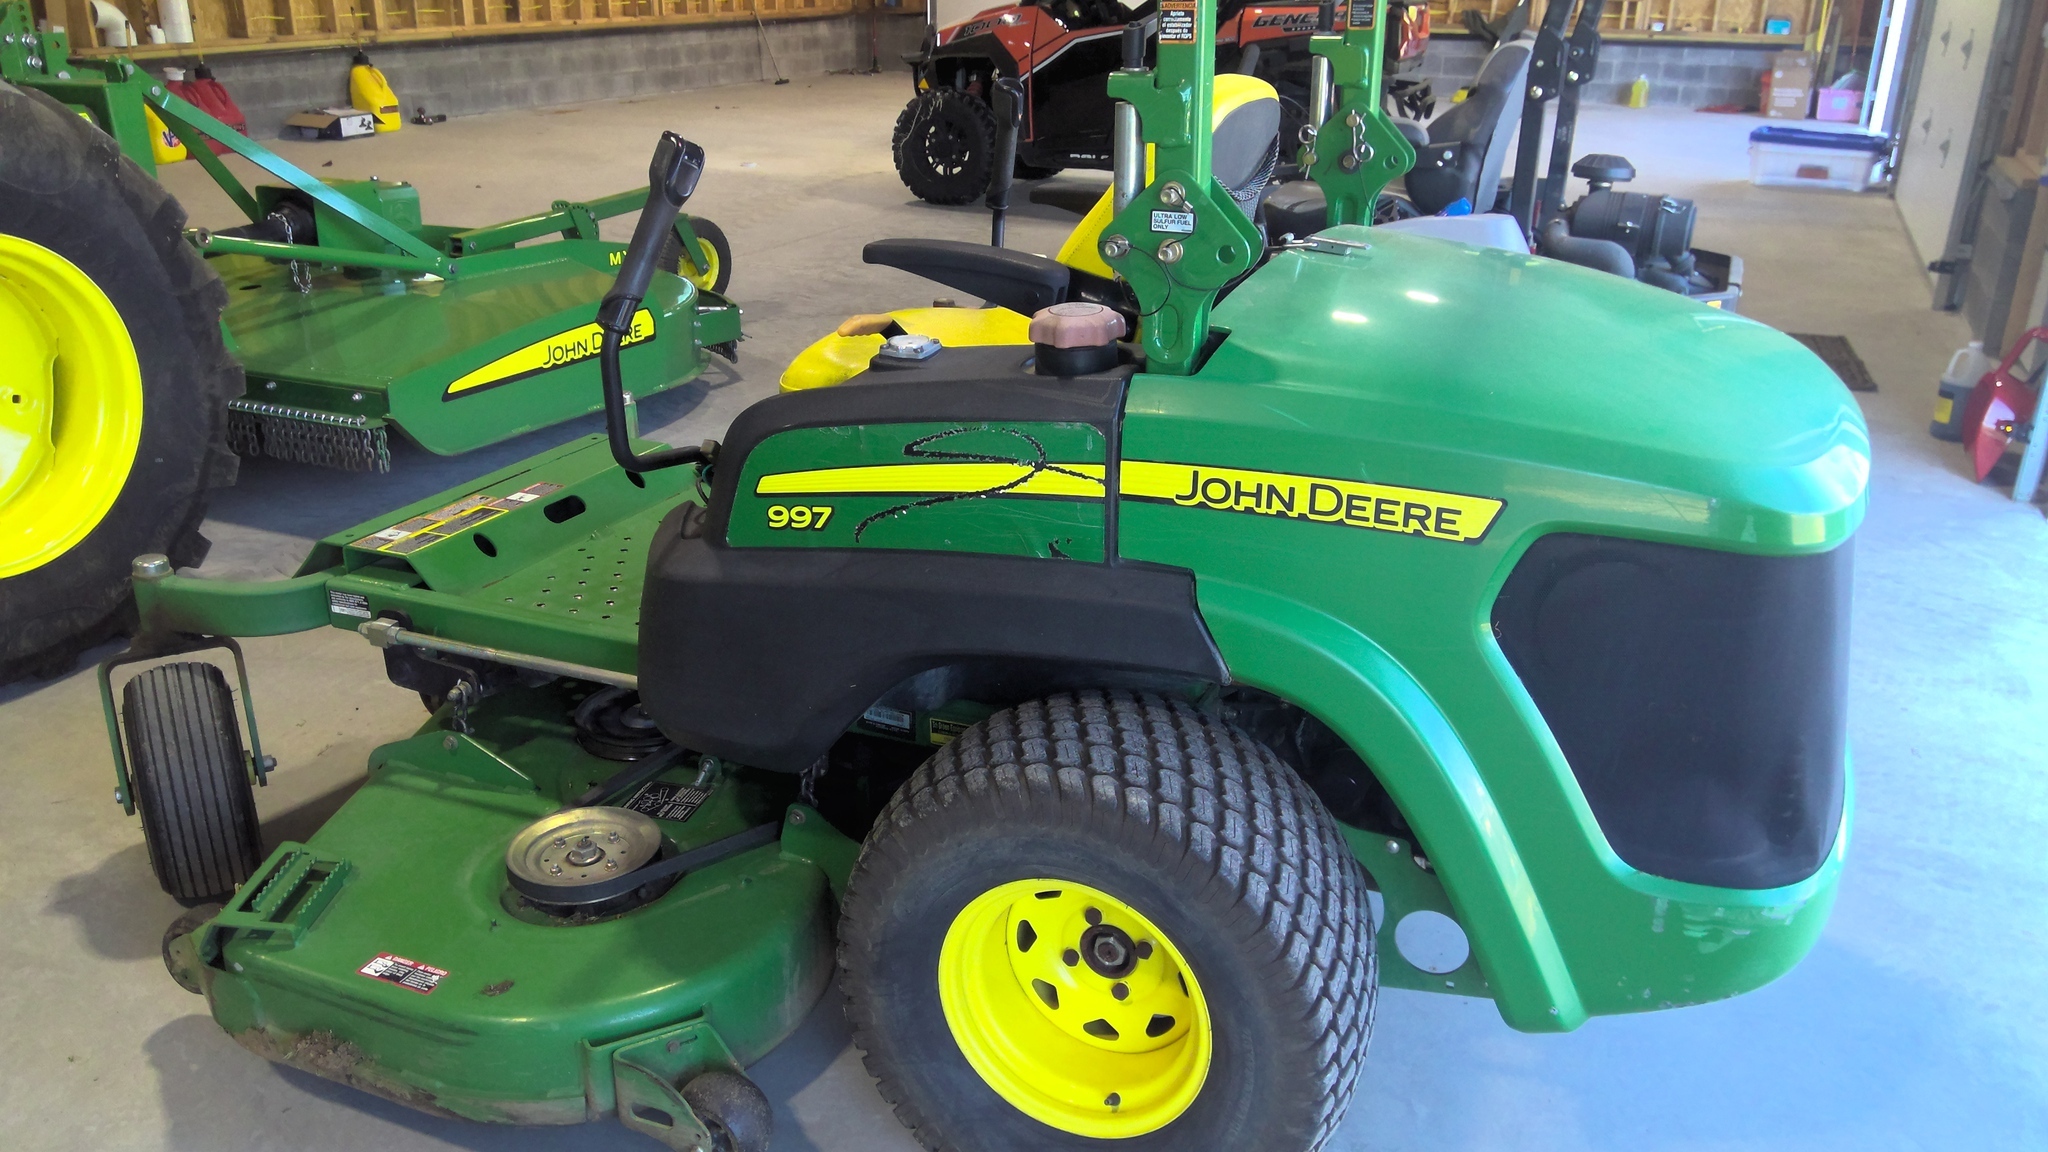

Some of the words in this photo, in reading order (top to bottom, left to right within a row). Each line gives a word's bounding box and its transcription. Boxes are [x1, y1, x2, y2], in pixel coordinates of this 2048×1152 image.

[543, 337, 588, 366] JOHN
[767, 505, 832, 529] 997
[1174, 470, 1296, 513] JOHN
[1308, 483, 1463, 536] DEERE
